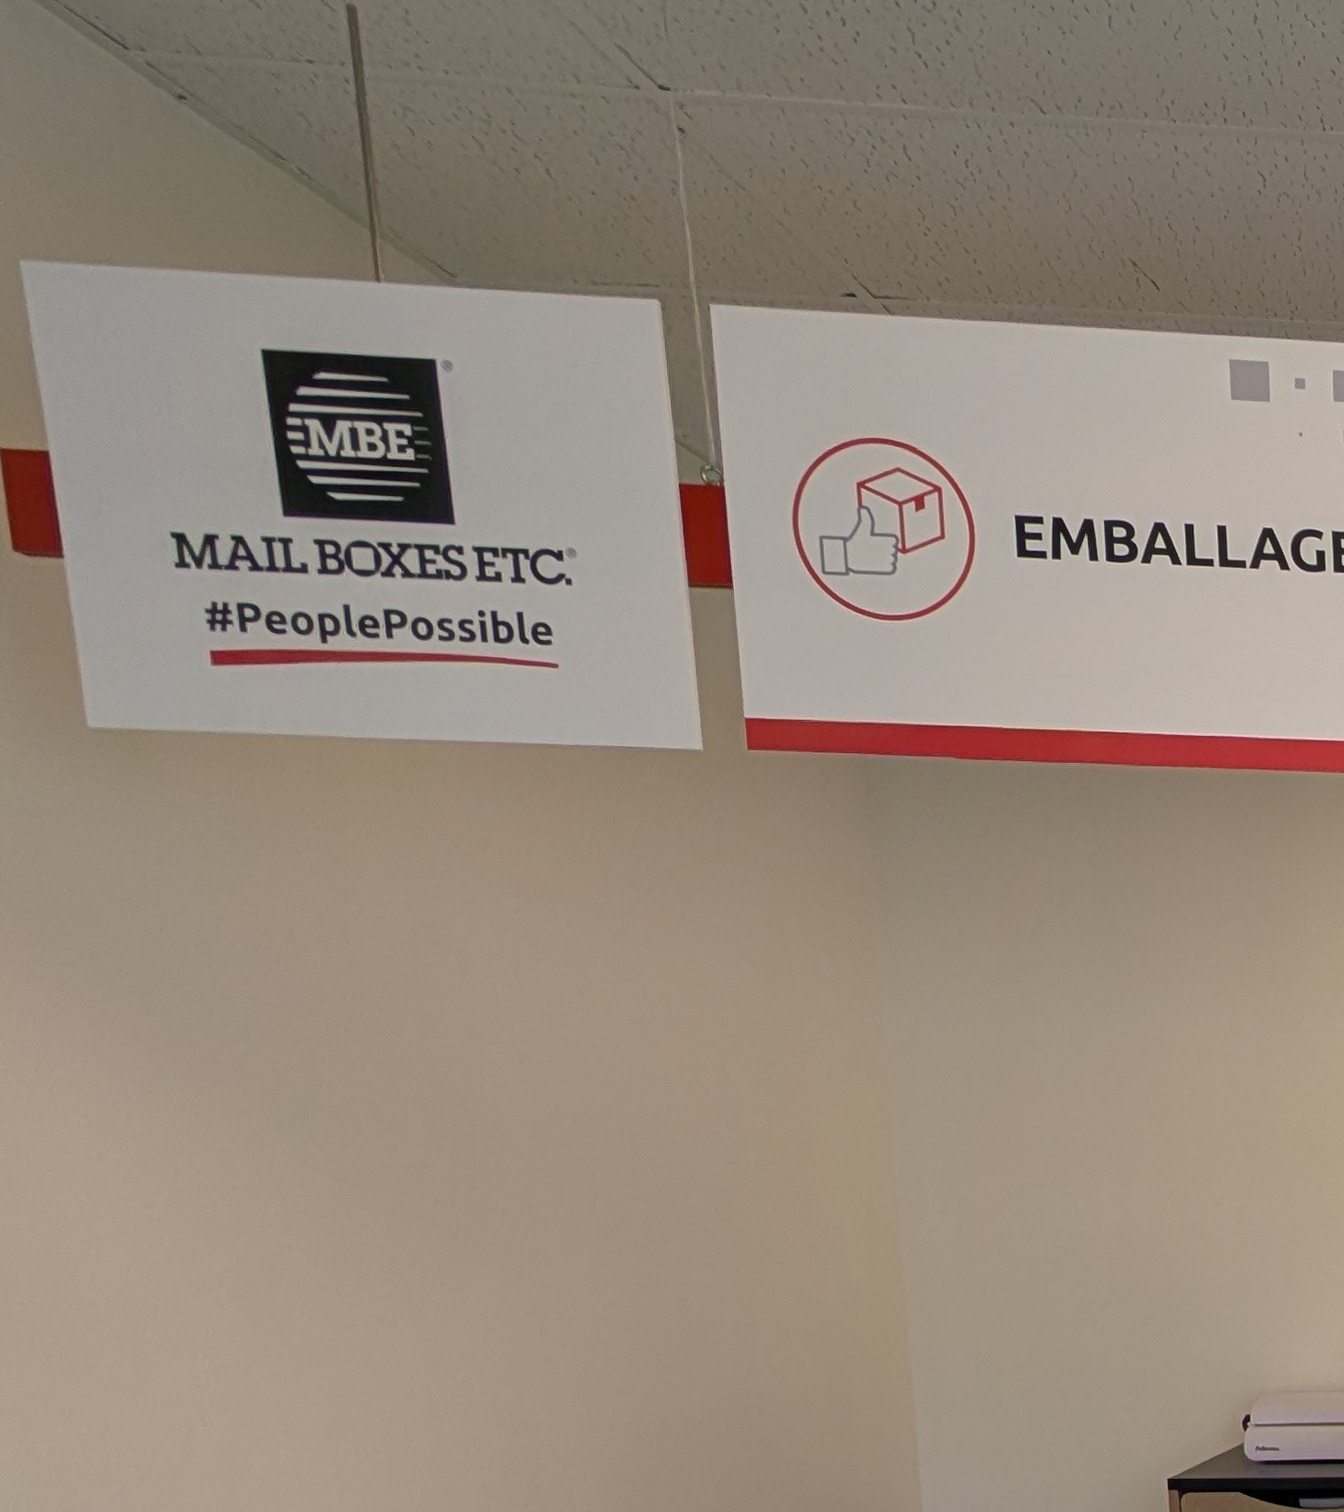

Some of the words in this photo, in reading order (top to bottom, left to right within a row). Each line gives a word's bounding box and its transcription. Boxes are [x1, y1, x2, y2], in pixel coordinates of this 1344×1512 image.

[304, 418, 415, 461] MBE
[169, 531, 308, 575] MAIL
[313, 538, 468, 582] BOXES
[205, 600, 554, 646] #PeoplePossible
